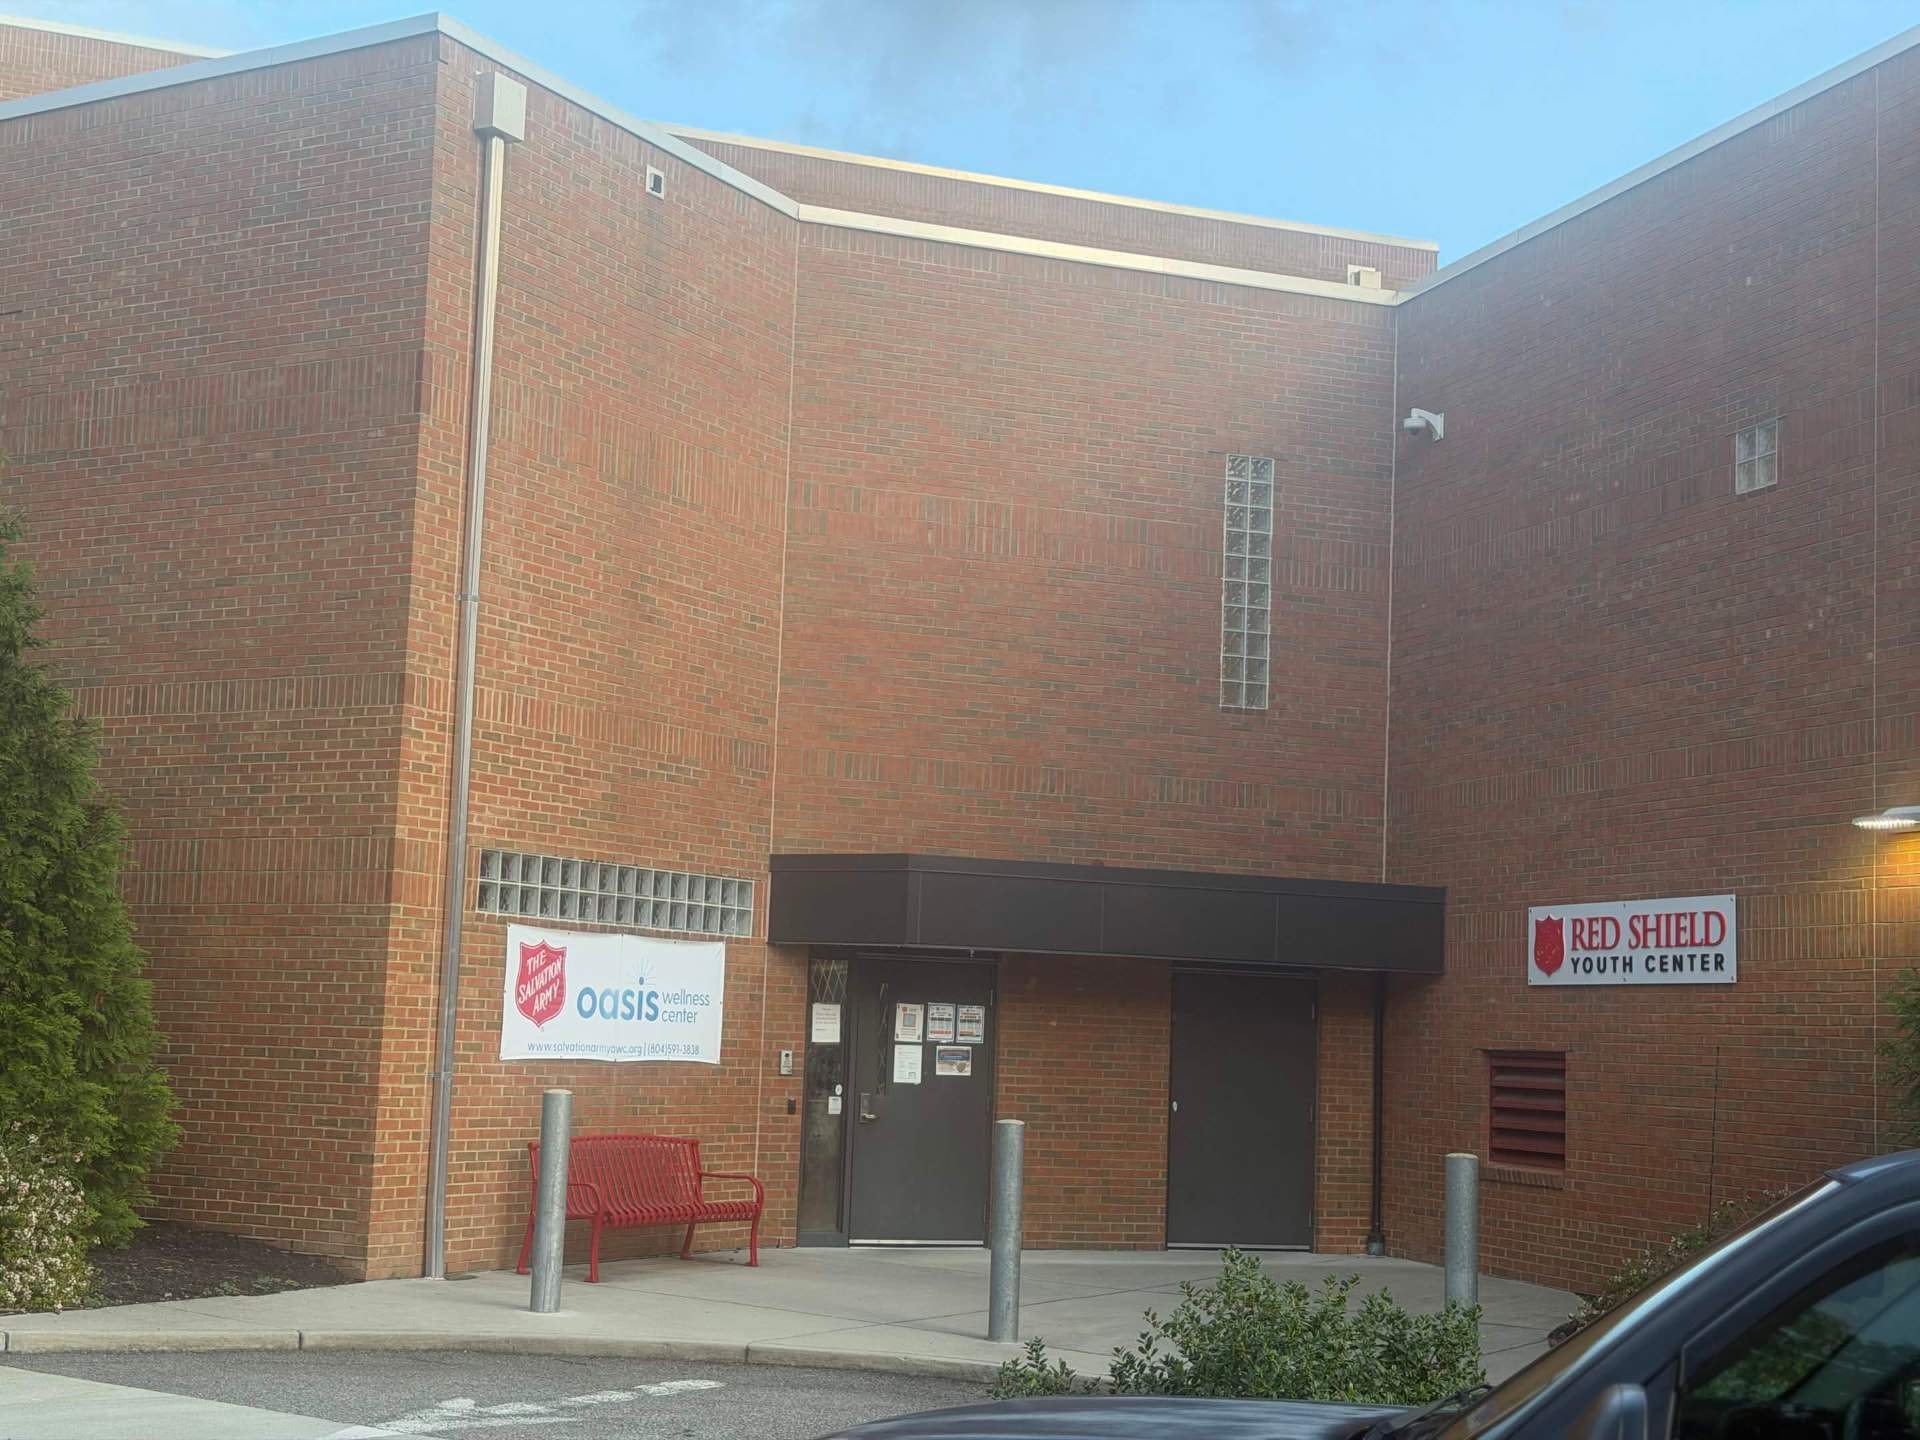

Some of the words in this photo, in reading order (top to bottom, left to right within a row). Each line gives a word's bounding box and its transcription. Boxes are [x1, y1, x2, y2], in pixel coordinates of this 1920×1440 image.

[1571, 917, 1621, 950] RED
[1628, 911, 1727, 949] SHIELD
[527, 950, 546, 975] THE
[1571, 956, 1633, 974] YOUTH
[1645, 954, 1725, 973] CENTER
[519, 955, 562, 1004] SALVATION
[532, 978, 559, 1016] ARMY
[577, 977, 659, 1021] oasis
[662, 989, 710, 1007] wellness
[662, 1008, 698, 1024] center
